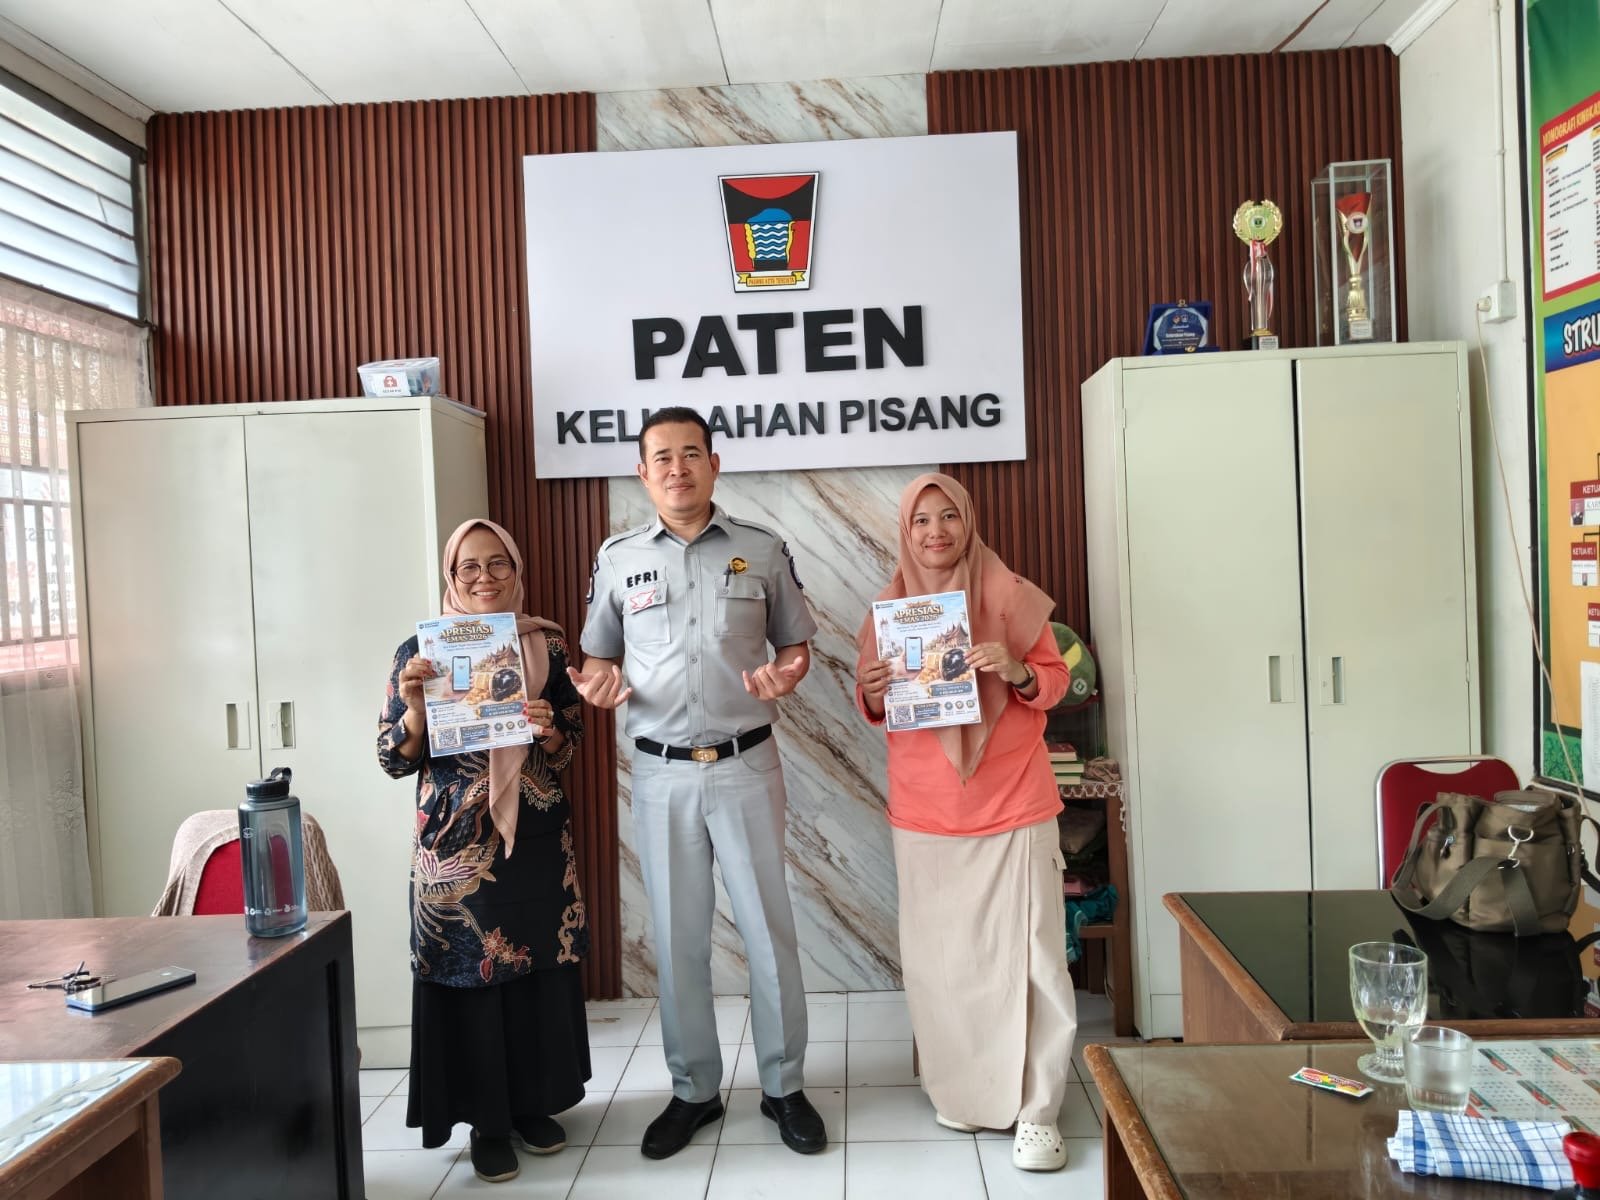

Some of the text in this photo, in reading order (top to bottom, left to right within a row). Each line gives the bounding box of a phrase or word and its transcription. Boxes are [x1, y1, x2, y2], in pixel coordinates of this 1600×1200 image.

[632, 305, 924, 380] PATEN
[557, 393, 1002, 444] KELAHAN PISANG
[626, 570, 657, 588] EFRI
[895, 604, 944, 619] APRESIASI
[440, 624, 494, 637] APRESIASI
